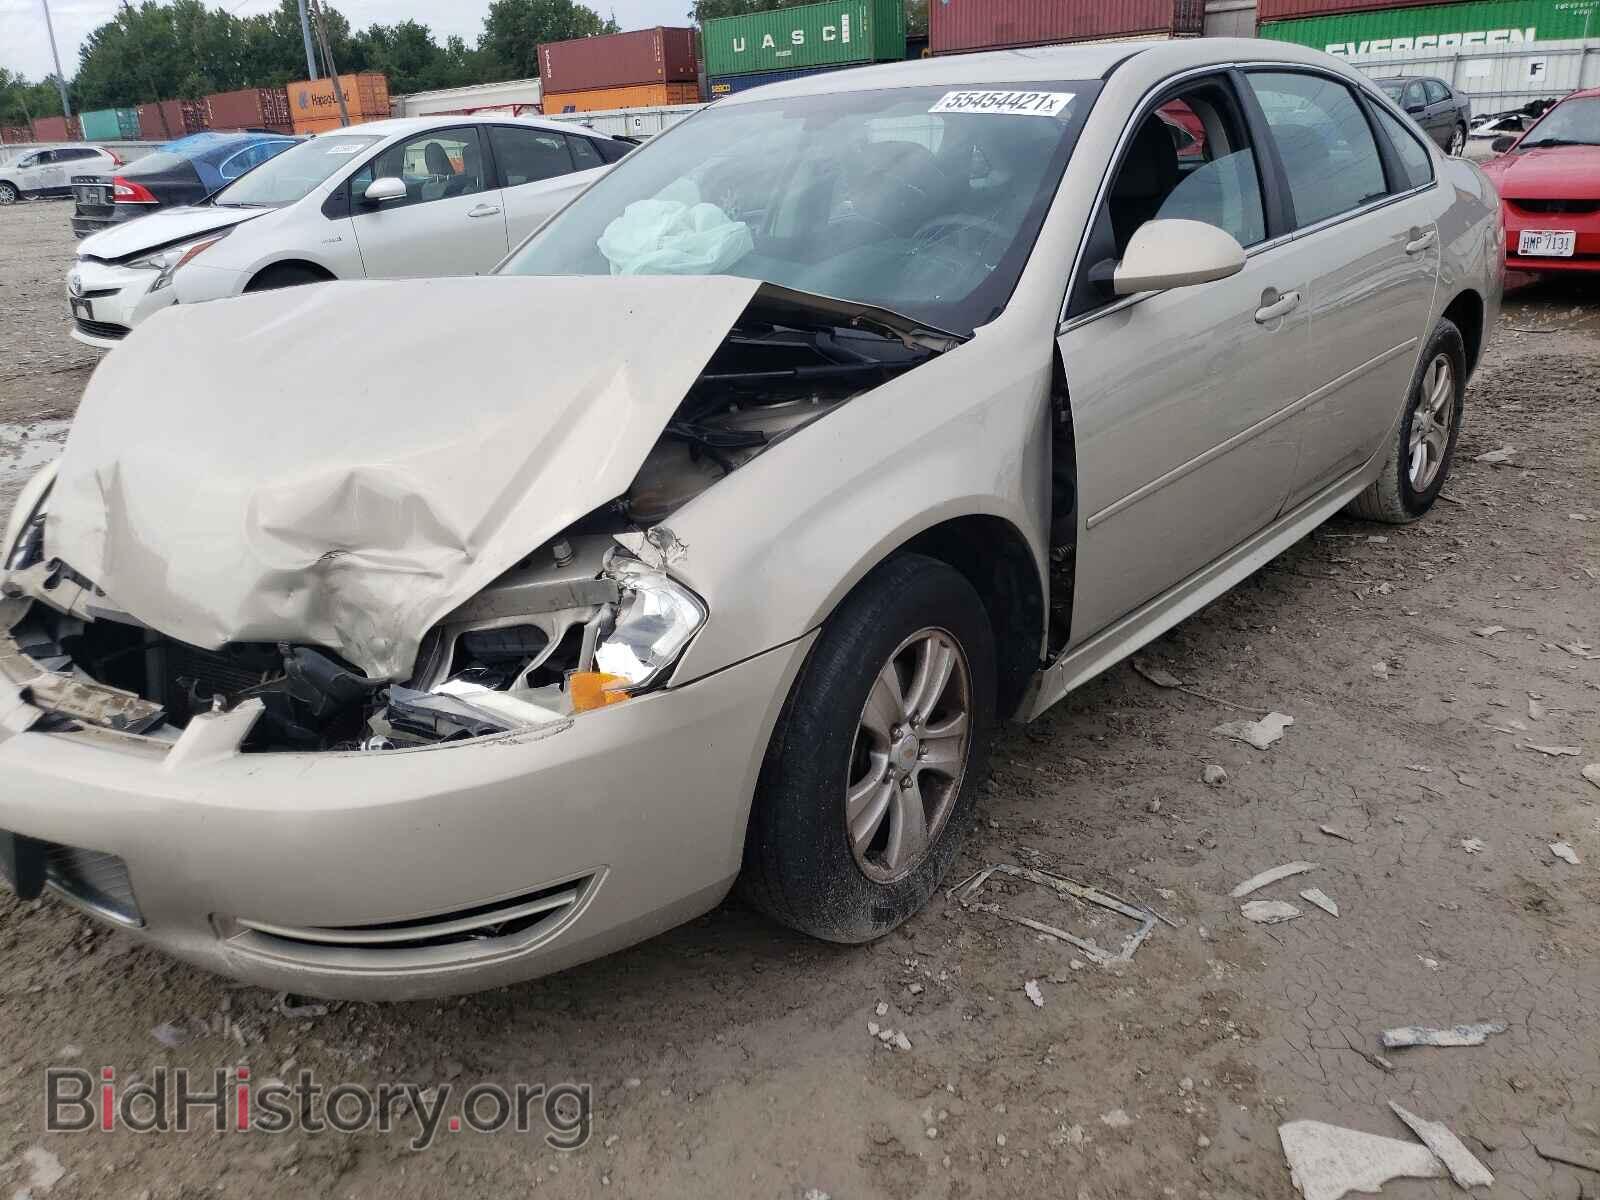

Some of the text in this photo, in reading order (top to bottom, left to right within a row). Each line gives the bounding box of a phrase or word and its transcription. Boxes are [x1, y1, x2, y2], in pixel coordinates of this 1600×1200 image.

[733, 25, 836, 52] UASC
[1530, 62, 1544, 76] F
[1522, 233, 1570, 250] HMP 7131
